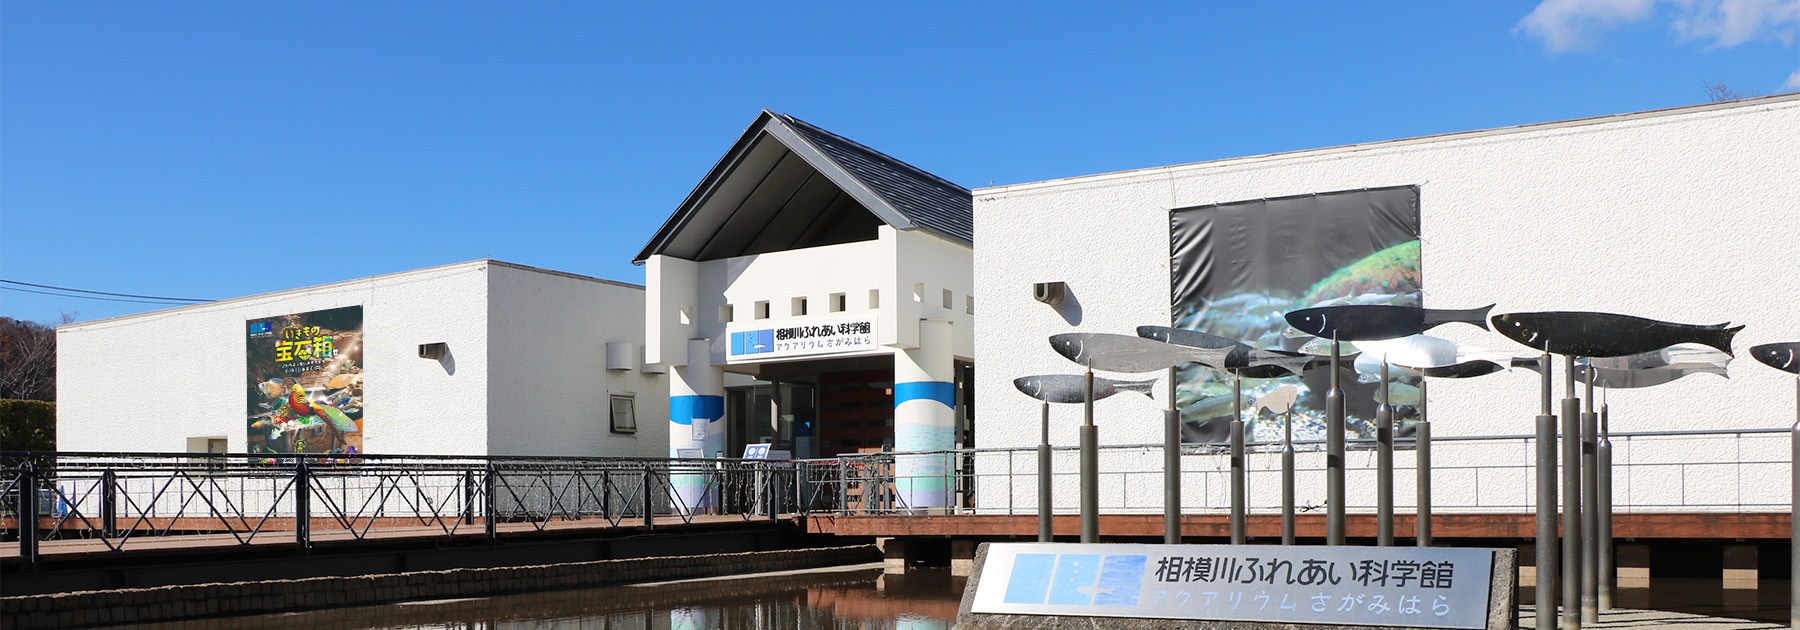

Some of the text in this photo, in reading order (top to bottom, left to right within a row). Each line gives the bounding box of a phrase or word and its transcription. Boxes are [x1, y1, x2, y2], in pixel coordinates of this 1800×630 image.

[285, 326, 320, 340] いきもの
[776, 321, 871, 341] 相模川ふれあい科学館
[275, 336, 333, 362] 宝石箱
[1155, 556, 1454, 589] 相模川ふれあい科学館
